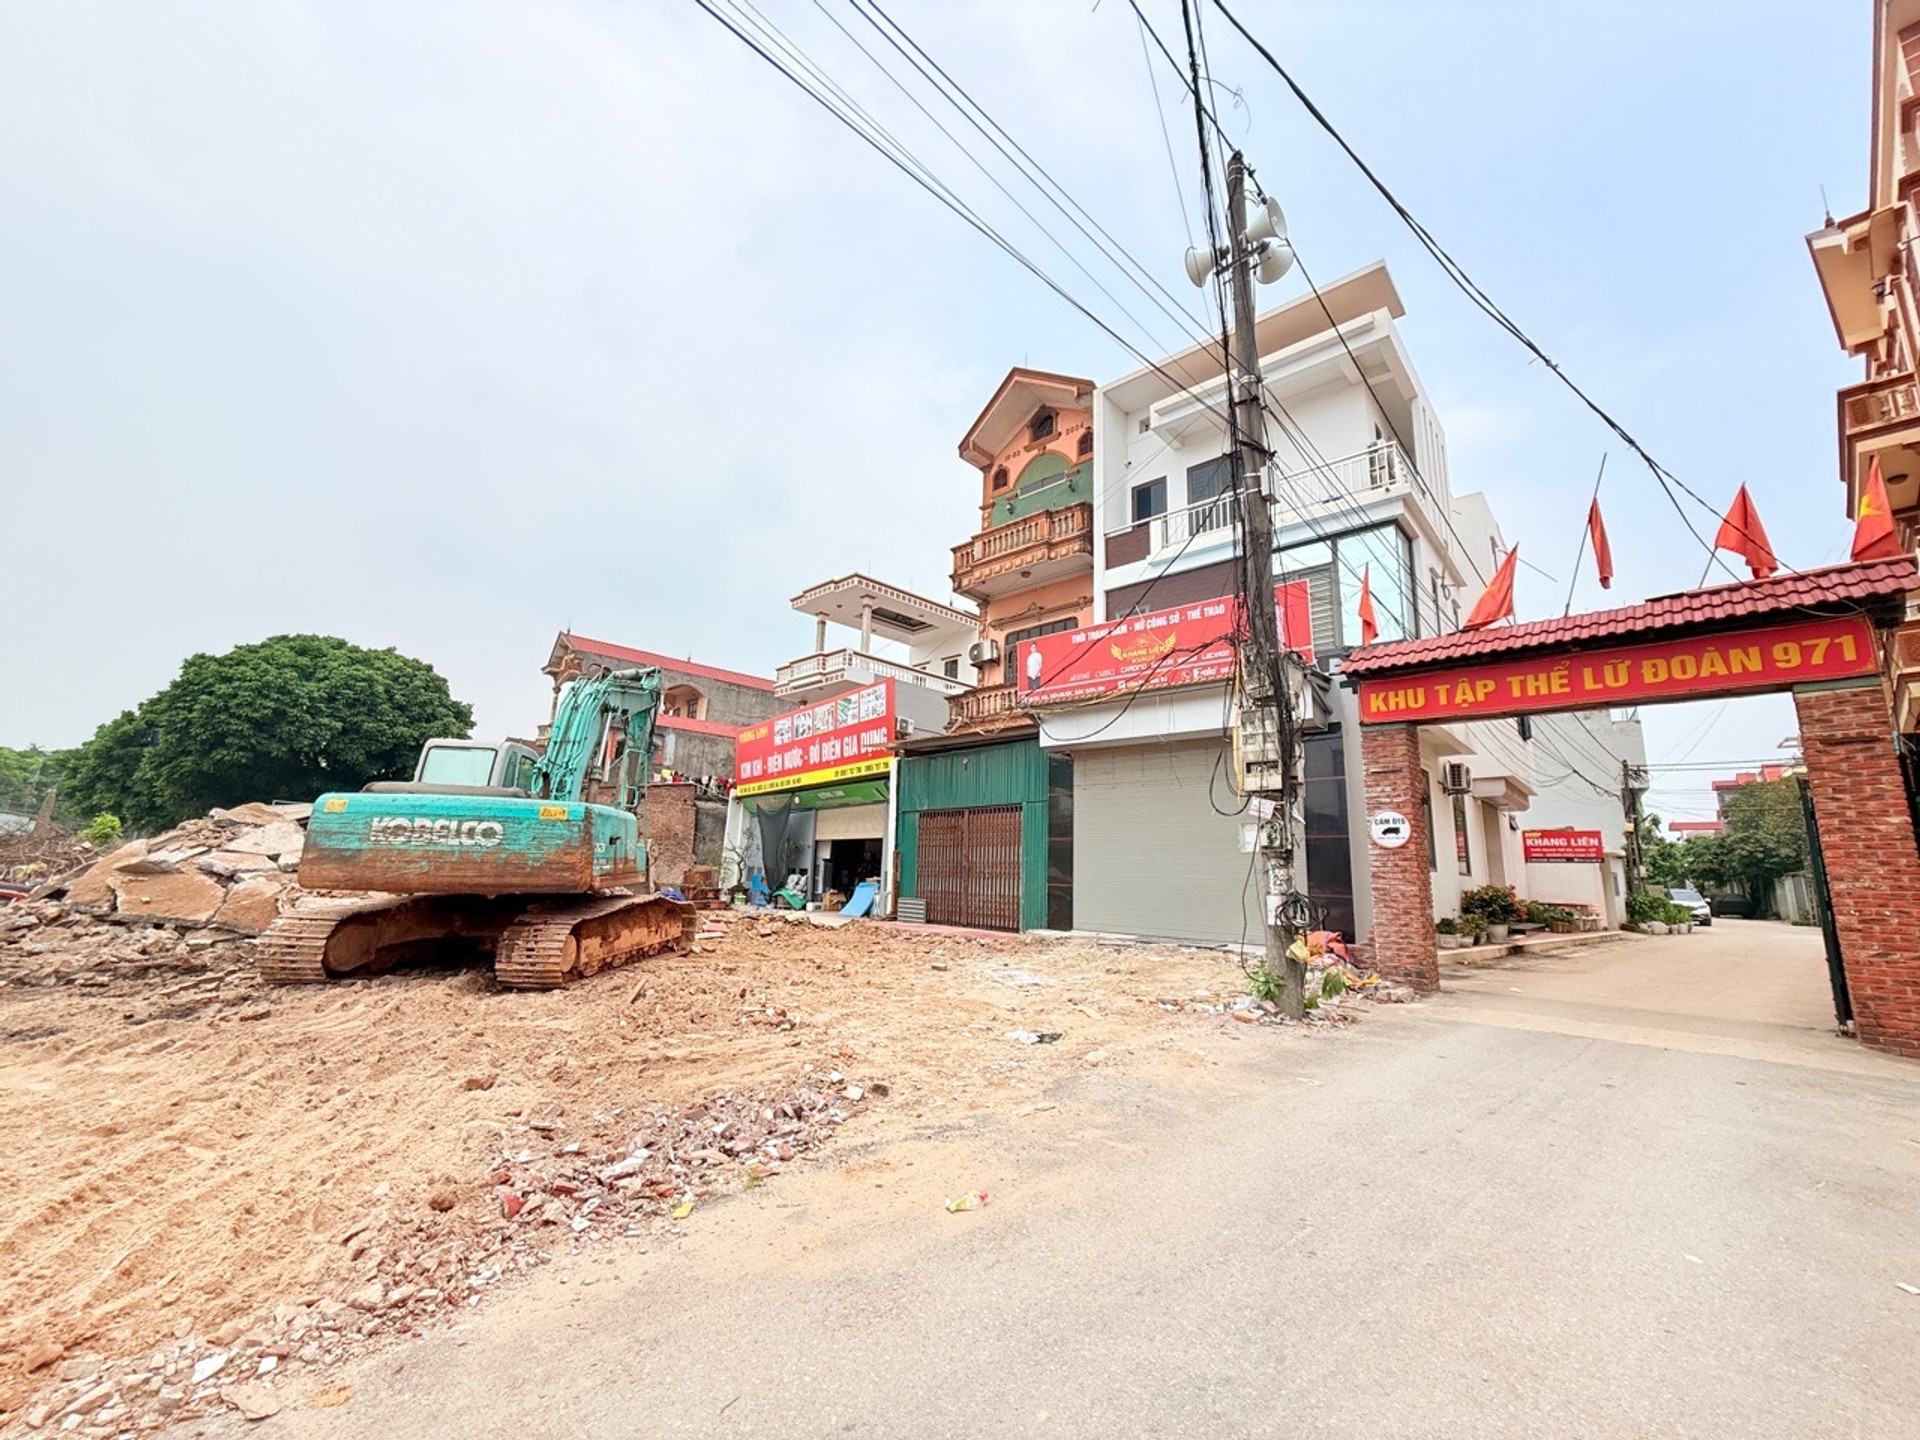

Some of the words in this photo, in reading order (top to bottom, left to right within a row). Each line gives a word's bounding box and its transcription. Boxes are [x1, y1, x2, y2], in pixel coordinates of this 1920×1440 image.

[1370, 686, 1425, 713] KHU
[1434, 677, 1496, 708] TẬP
[1507, 660, 1571, 699] THỂ
[1583, 656, 1632, 690] LỮ
[1642, 646, 1763, 684] ĐOÀN
[1772, 634, 1858, 669] 971
[821, 736, 842, 764] ĐIỆN
[843, 735, 858, 757] GIA
[369, 816, 503, 847] KOBELCO
[1526, 838, 1568, 847] KHANG
[1570, 836, 1599, 847] LIÊN
